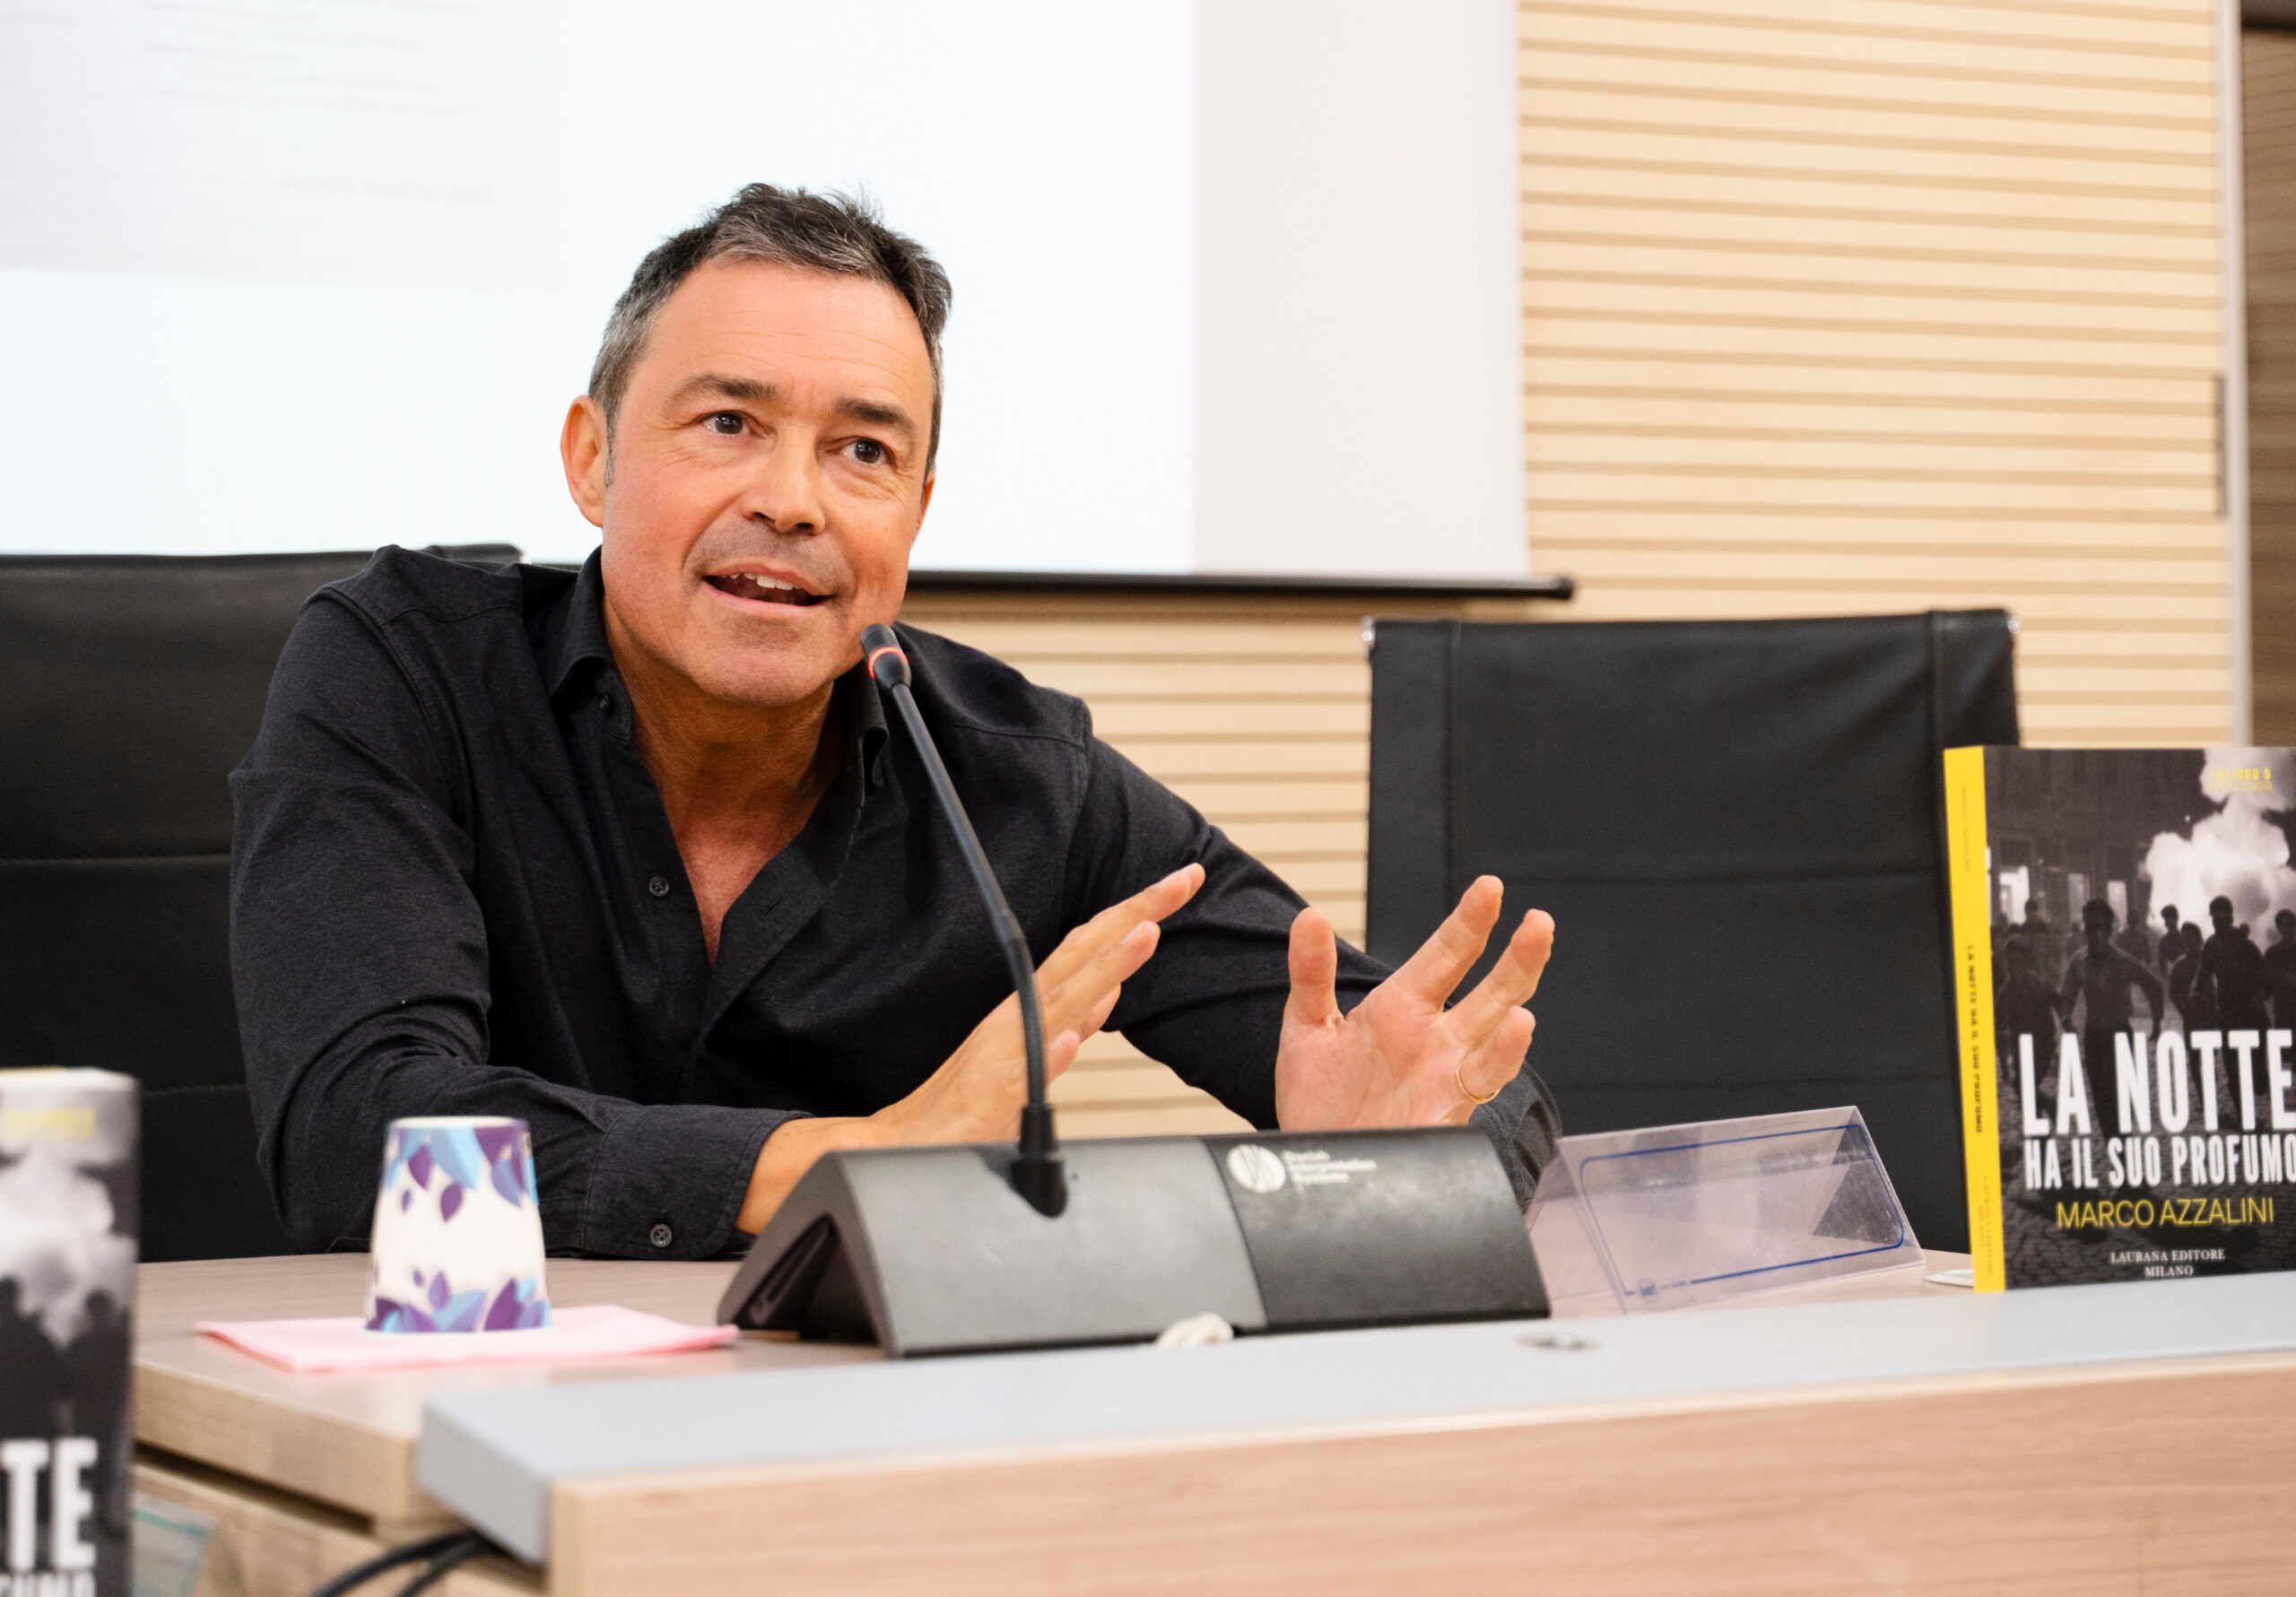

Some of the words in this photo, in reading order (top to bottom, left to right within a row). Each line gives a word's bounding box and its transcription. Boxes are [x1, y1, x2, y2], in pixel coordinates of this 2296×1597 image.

[2019, 1032, 2092, 1136] LA
[2113, 1029, 2296, 1134] NOTTE
[2024, 1138, 2063, 1190] HA
[2071, 1138, 2100, 1189] IL
[2108, 1136, 2162, 1188] SUO
[2170, 1133, 2296, 1186] PROFUMO
[2056, 1200, 2154, 1229] MARCO
[2159, 1196, 2274, 1227] AZZALINI
[2110, 1251, 2169, 1263] LAURANA
[2171, 1248, 2226, 1262] EDITORE
[2144, 1264, 2194, 1278] MILANO
